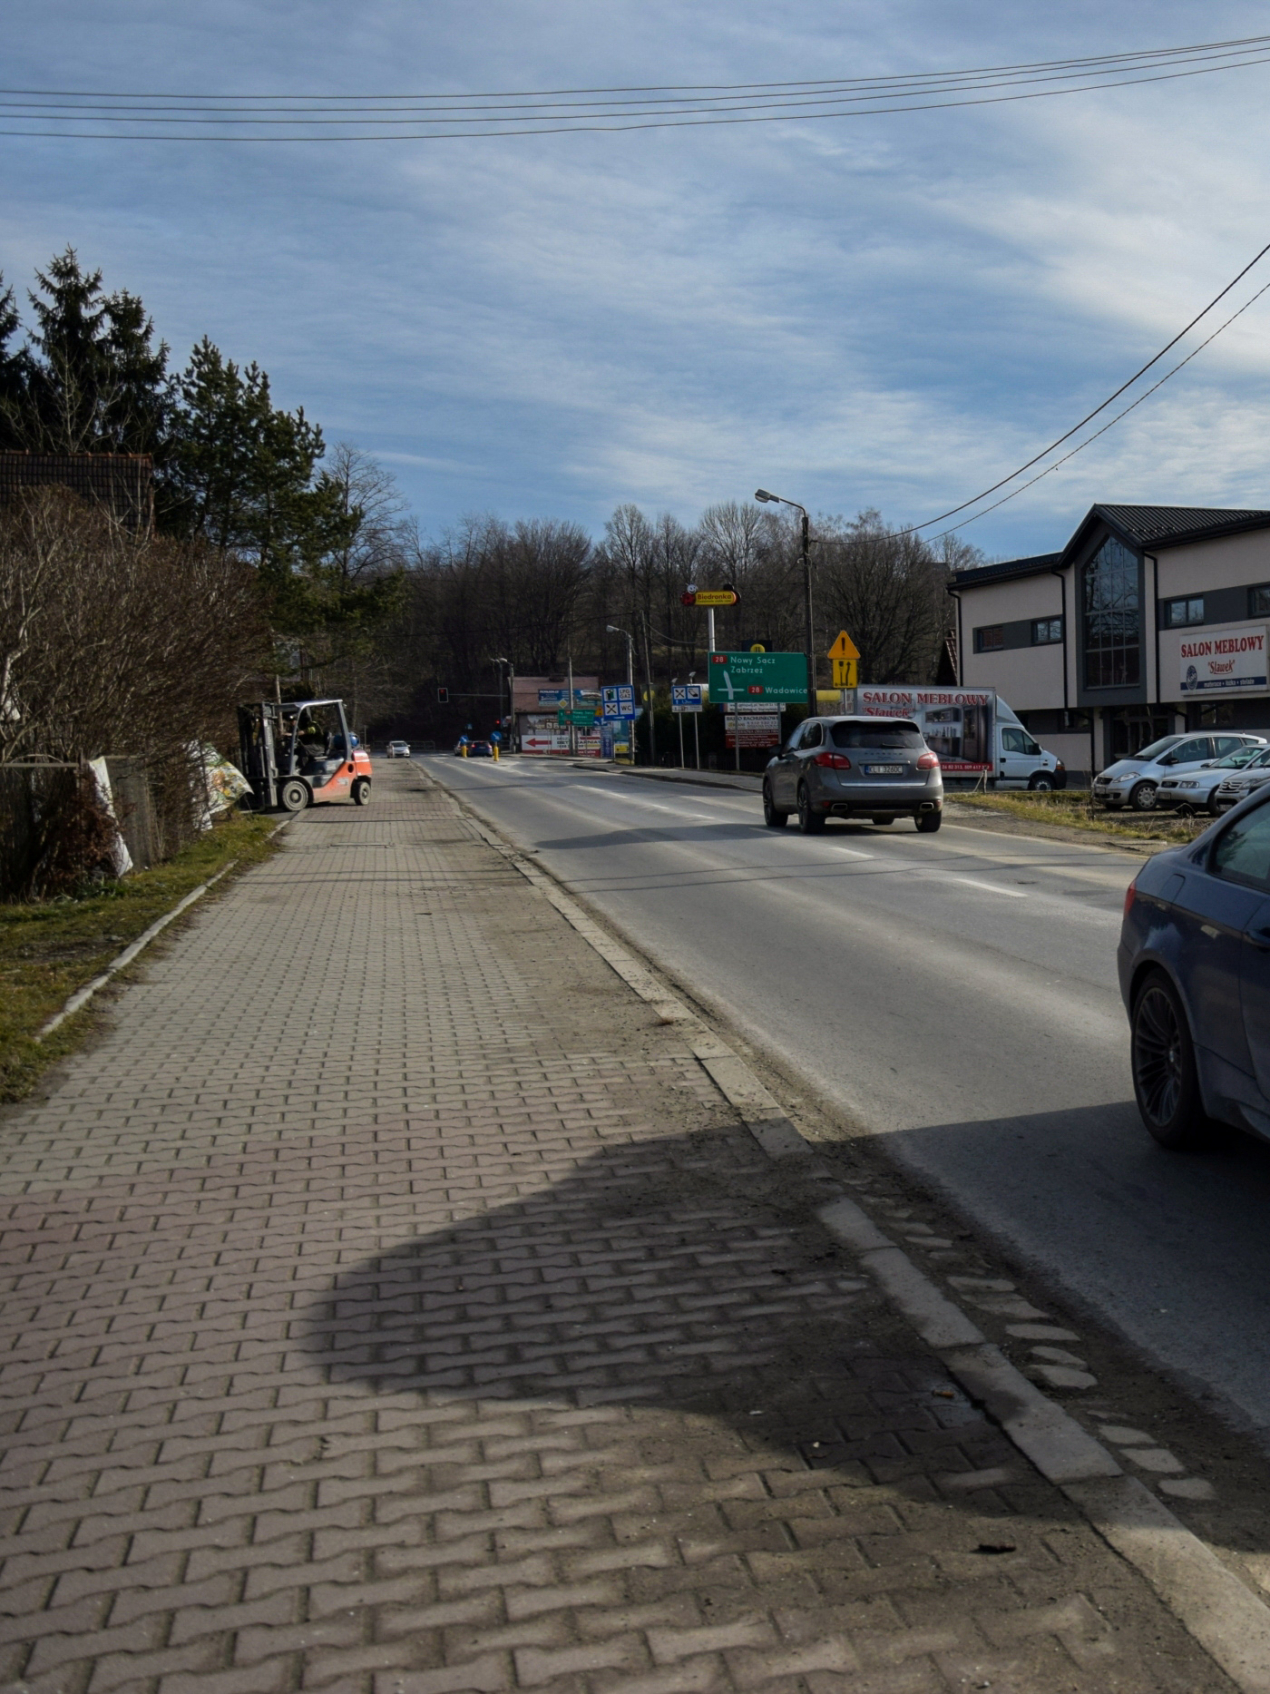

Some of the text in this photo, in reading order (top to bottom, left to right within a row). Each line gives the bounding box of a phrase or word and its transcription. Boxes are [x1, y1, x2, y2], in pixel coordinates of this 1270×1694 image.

[1181, 635, 1264, 658] SALON MEBLOWY
[730, 656, 753, 665] Nowy
[757, 657, 776, 665] Sącz
[765, 686, 808, 694] Wadowice
[863, 692, 912, 704] SALON
[917, 693, 990, 706] MEBLOWY
